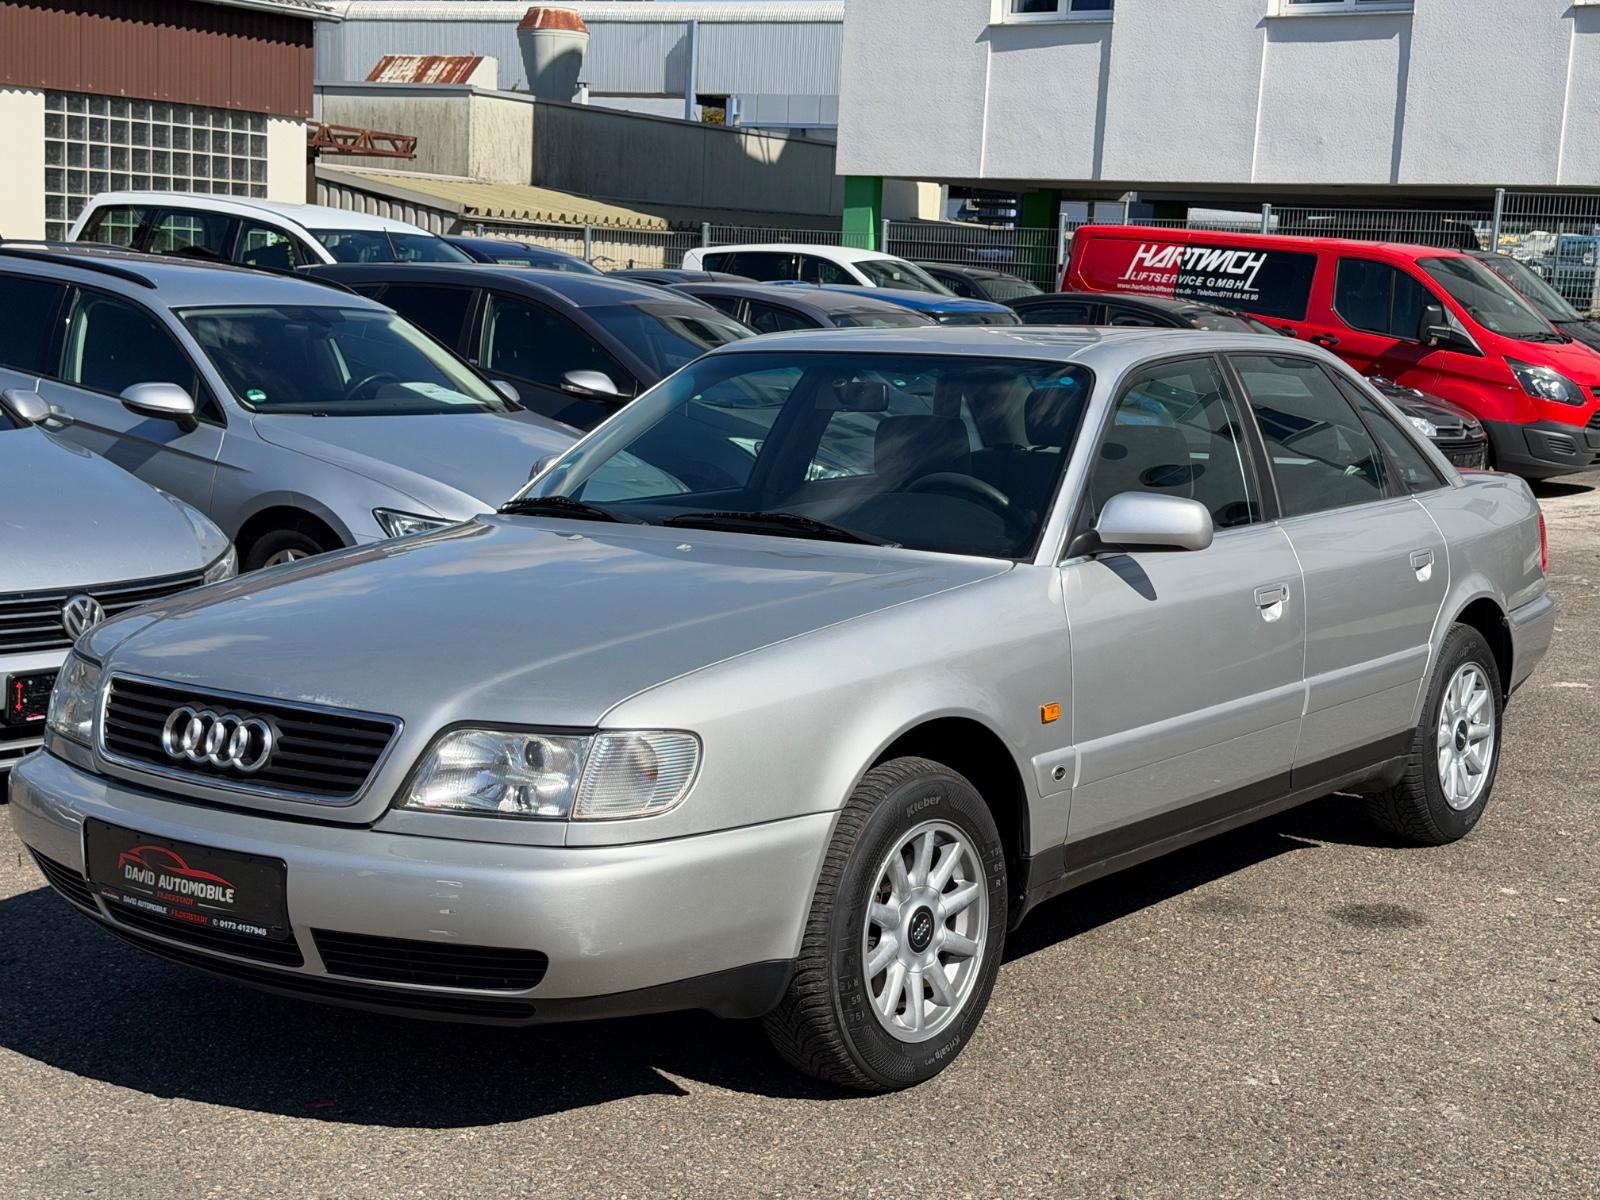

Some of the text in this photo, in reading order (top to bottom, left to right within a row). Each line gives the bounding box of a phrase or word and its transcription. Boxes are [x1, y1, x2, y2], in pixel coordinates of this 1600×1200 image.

[1119, 243, 1267, 289] HARTWICH
[1116, 283, 1192, 295] www.hartwich-liftservce.de
[1130, 271, 1245, 289] LIFTSERVICE GMBH
[906, 796, 942, 818] Kleber
[124, 864, 235, 904] DAVID AUTOMOBILE
[219, 920, 237, 930] 0173
[236, 923, 267, 936] 4127945
